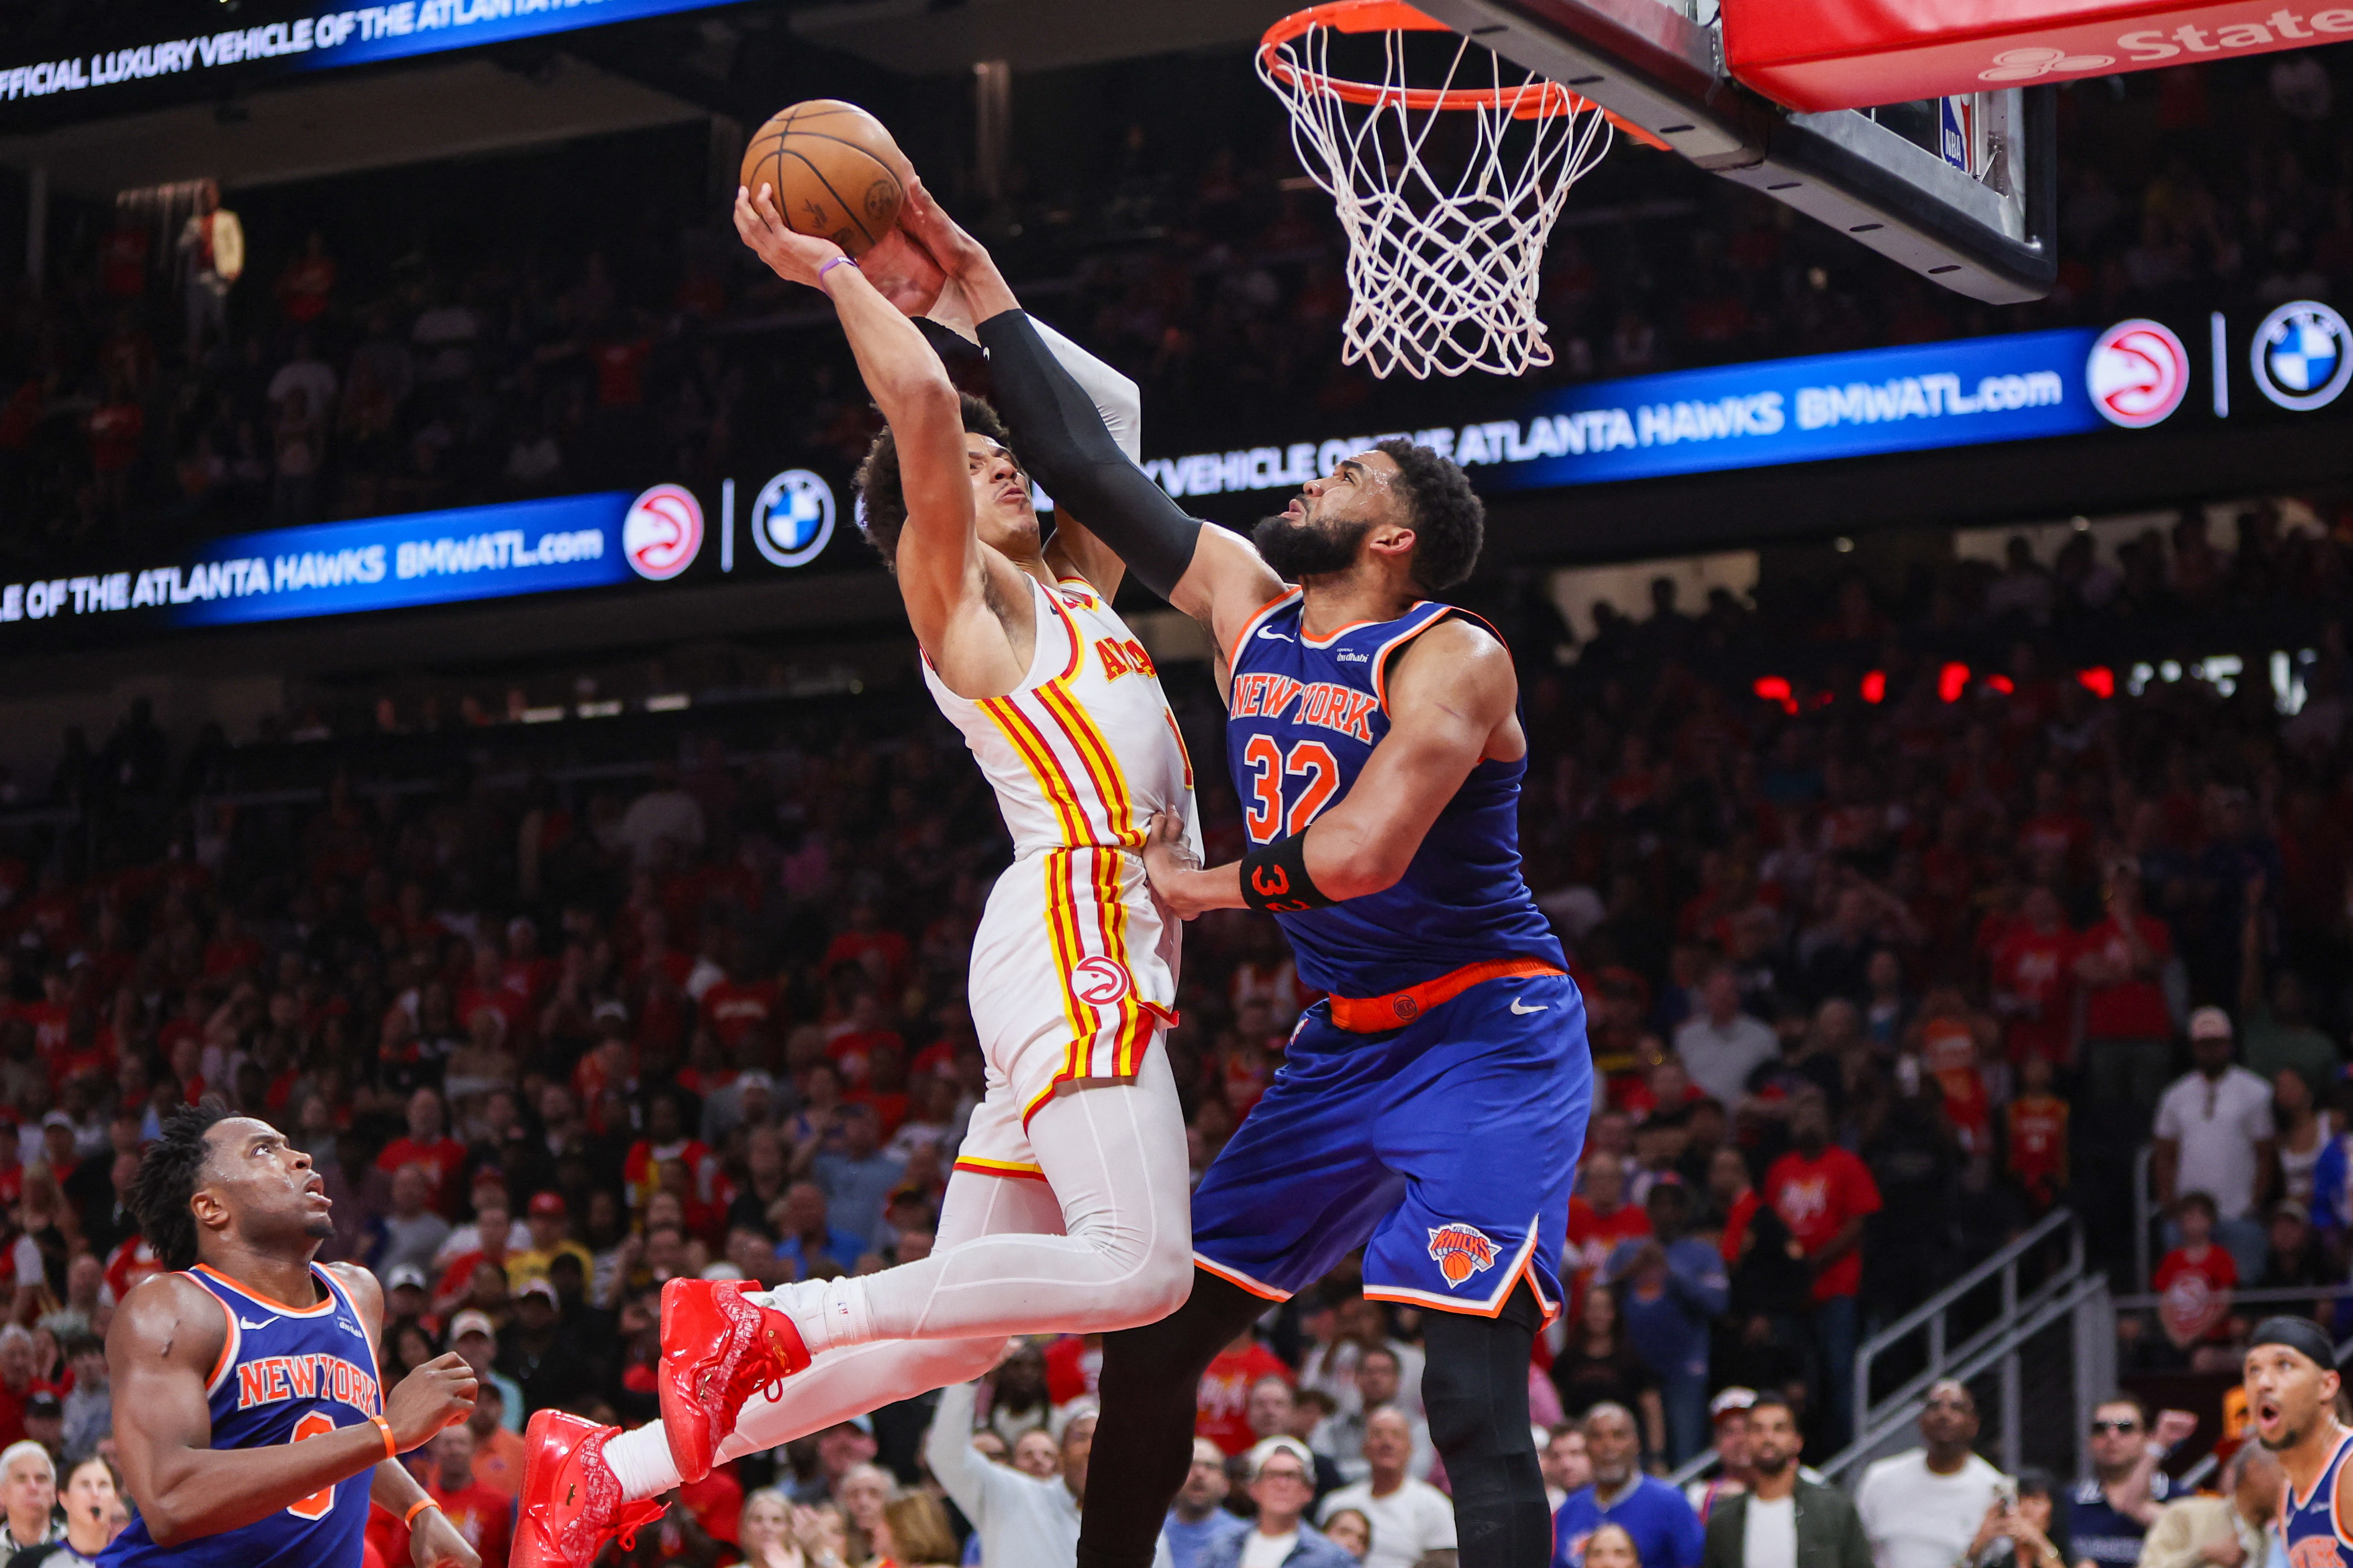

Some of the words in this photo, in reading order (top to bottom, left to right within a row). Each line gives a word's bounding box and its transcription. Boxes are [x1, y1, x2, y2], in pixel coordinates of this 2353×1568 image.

[90, 37, 198, 87] LUXURY
[197, 17, 314, 68] VEHICLE
[314, 11, 357, 48] OF
[356, 3, 416, 41] THE
[2117, 9, 2353, 61] State
[1945, 128, 1962, 163] NBA
[1159, 442, 1318, 498] VEHICLE
[1455, 407, 1637, 467] ATLANTA
[1636, 391, 1785, 447] HAWKS
[1795, 370, 2063, 431] BMWATL.com
[26, 578, 68, 620] OF
[68, 572, 131, 614] THE
[131, 557, 271, 608] ATLANTA
[273, 544, 387, 593] HAWKS
[395, 528, 604, 580] BMWATL.com
[1230, 672, 1307, 722] NEW
[1292, 682, 1380, 746] YORK
[1245, 733, 1340, 845] 32
[1430, 1229, 1491, 1265] KNICKS
[1465, 1227, 1479, 1238] YORK
[236, 1354, 317, 1411] NEW
[316, 1353, 376, 1419] YORK
